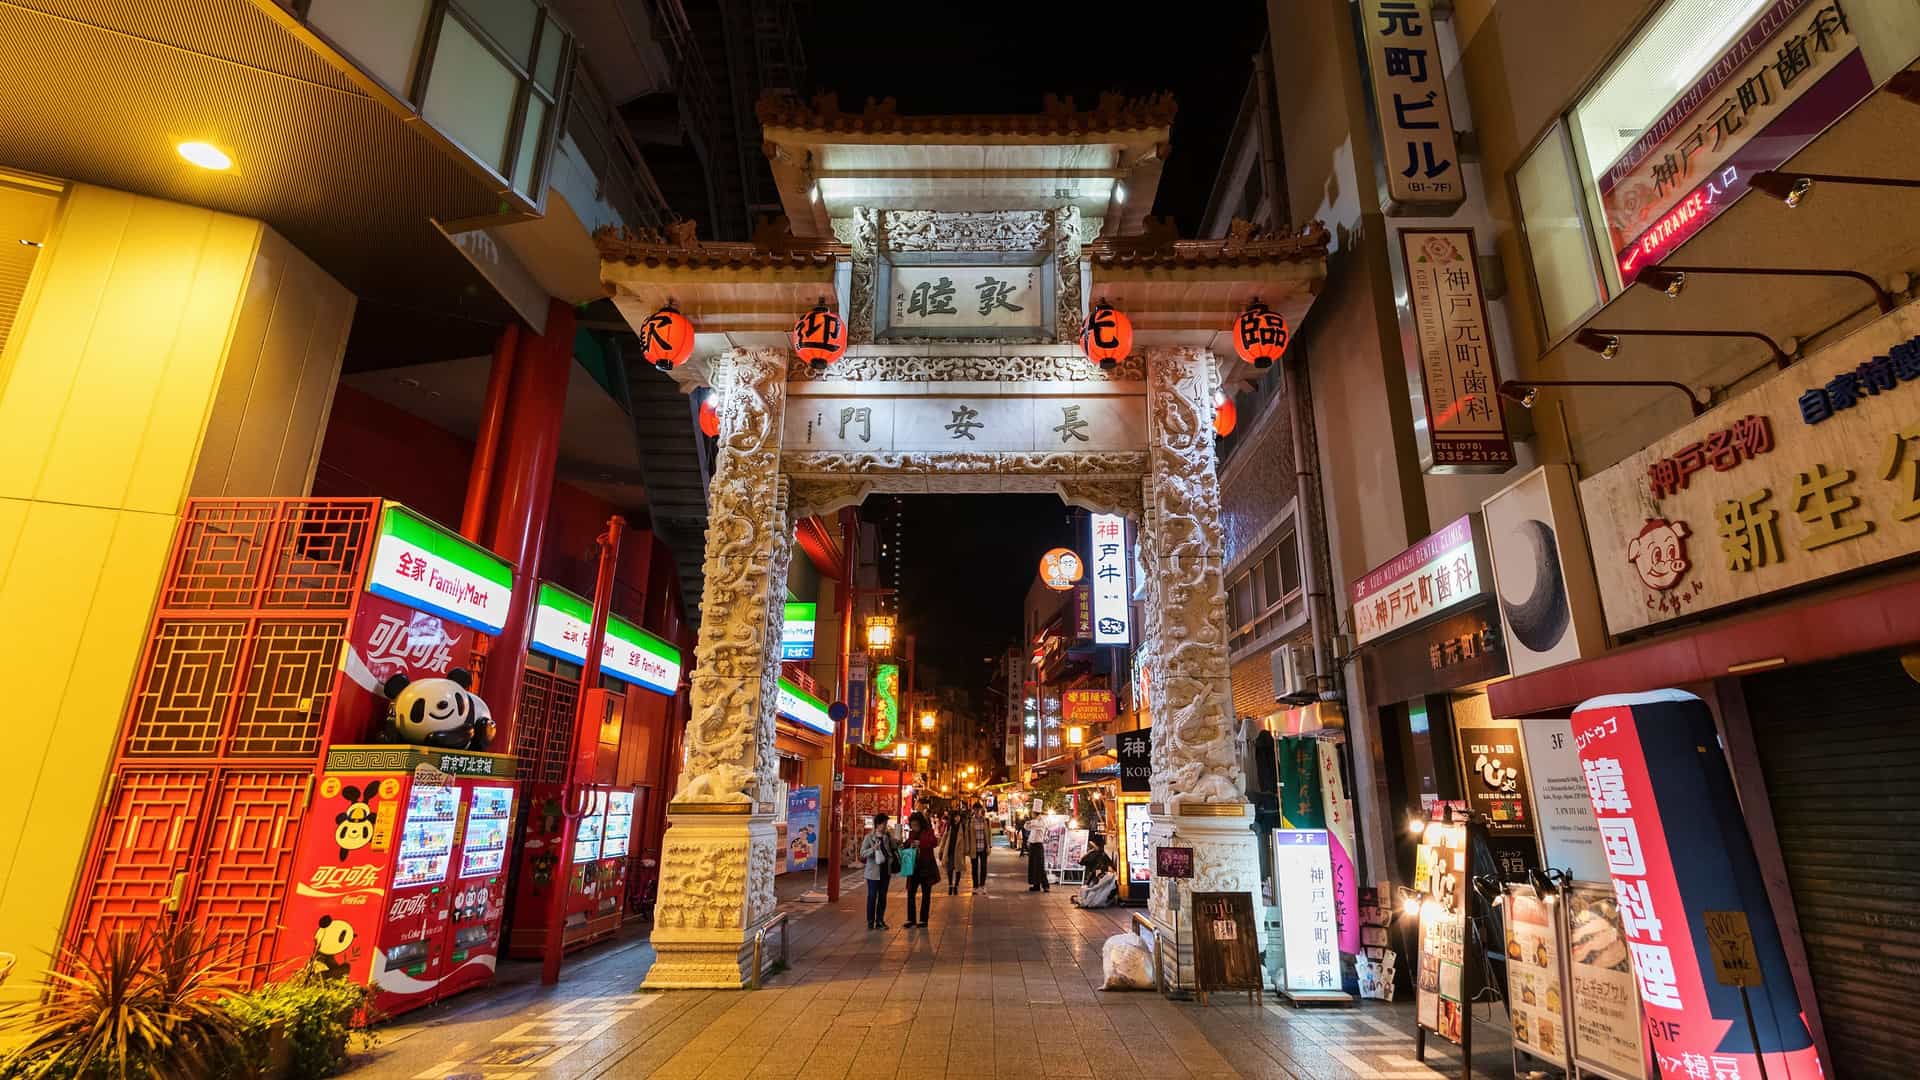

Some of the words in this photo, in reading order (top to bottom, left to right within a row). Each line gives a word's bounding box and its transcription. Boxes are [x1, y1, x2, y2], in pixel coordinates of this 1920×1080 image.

[1378, 2, 1450, 179] 元町ビル
[1611, 154, 1635, 184] KOBE
[1638, 85, 1704, 153] MOTOMACHI
[1706, 41, 1757, 87] DENTAL
[1651, 0, 1850, 198] 神戸元町歯科
[1642, 192, 1704, 253] ENTRANCE
[1705, 165, 1737, 205] 入口
[796, 312, 841, 352] 迎
[1240, 309, 1286, 350] 臨
[1443, 267, 1493, 423] 神戸元町歯科
[1435, 442, 1453, 450] TEL
[1437, 451, 1509, 461] 335-2122
[1648, 415, 1774, 500] 神戸名物
[395, 551, 427, 582] 全家
[428, 570, 488, 609] FamilyMart
[1097, 521, 1121, 584] 神戸牛
[1375, 553, 1473, 631] 神戸元町歯科
[1646, 580, 1703, 613] とんちゃん
[642, 657, 667, 678] FamilyMart
[1551, 733, 1564, 750] 3F
[1296, 834, 1314, 843] 2F
[1582, 757, 1683, 1010] 韓国料理
[1311, 866, 1333, 988] 神戸元町歯科
